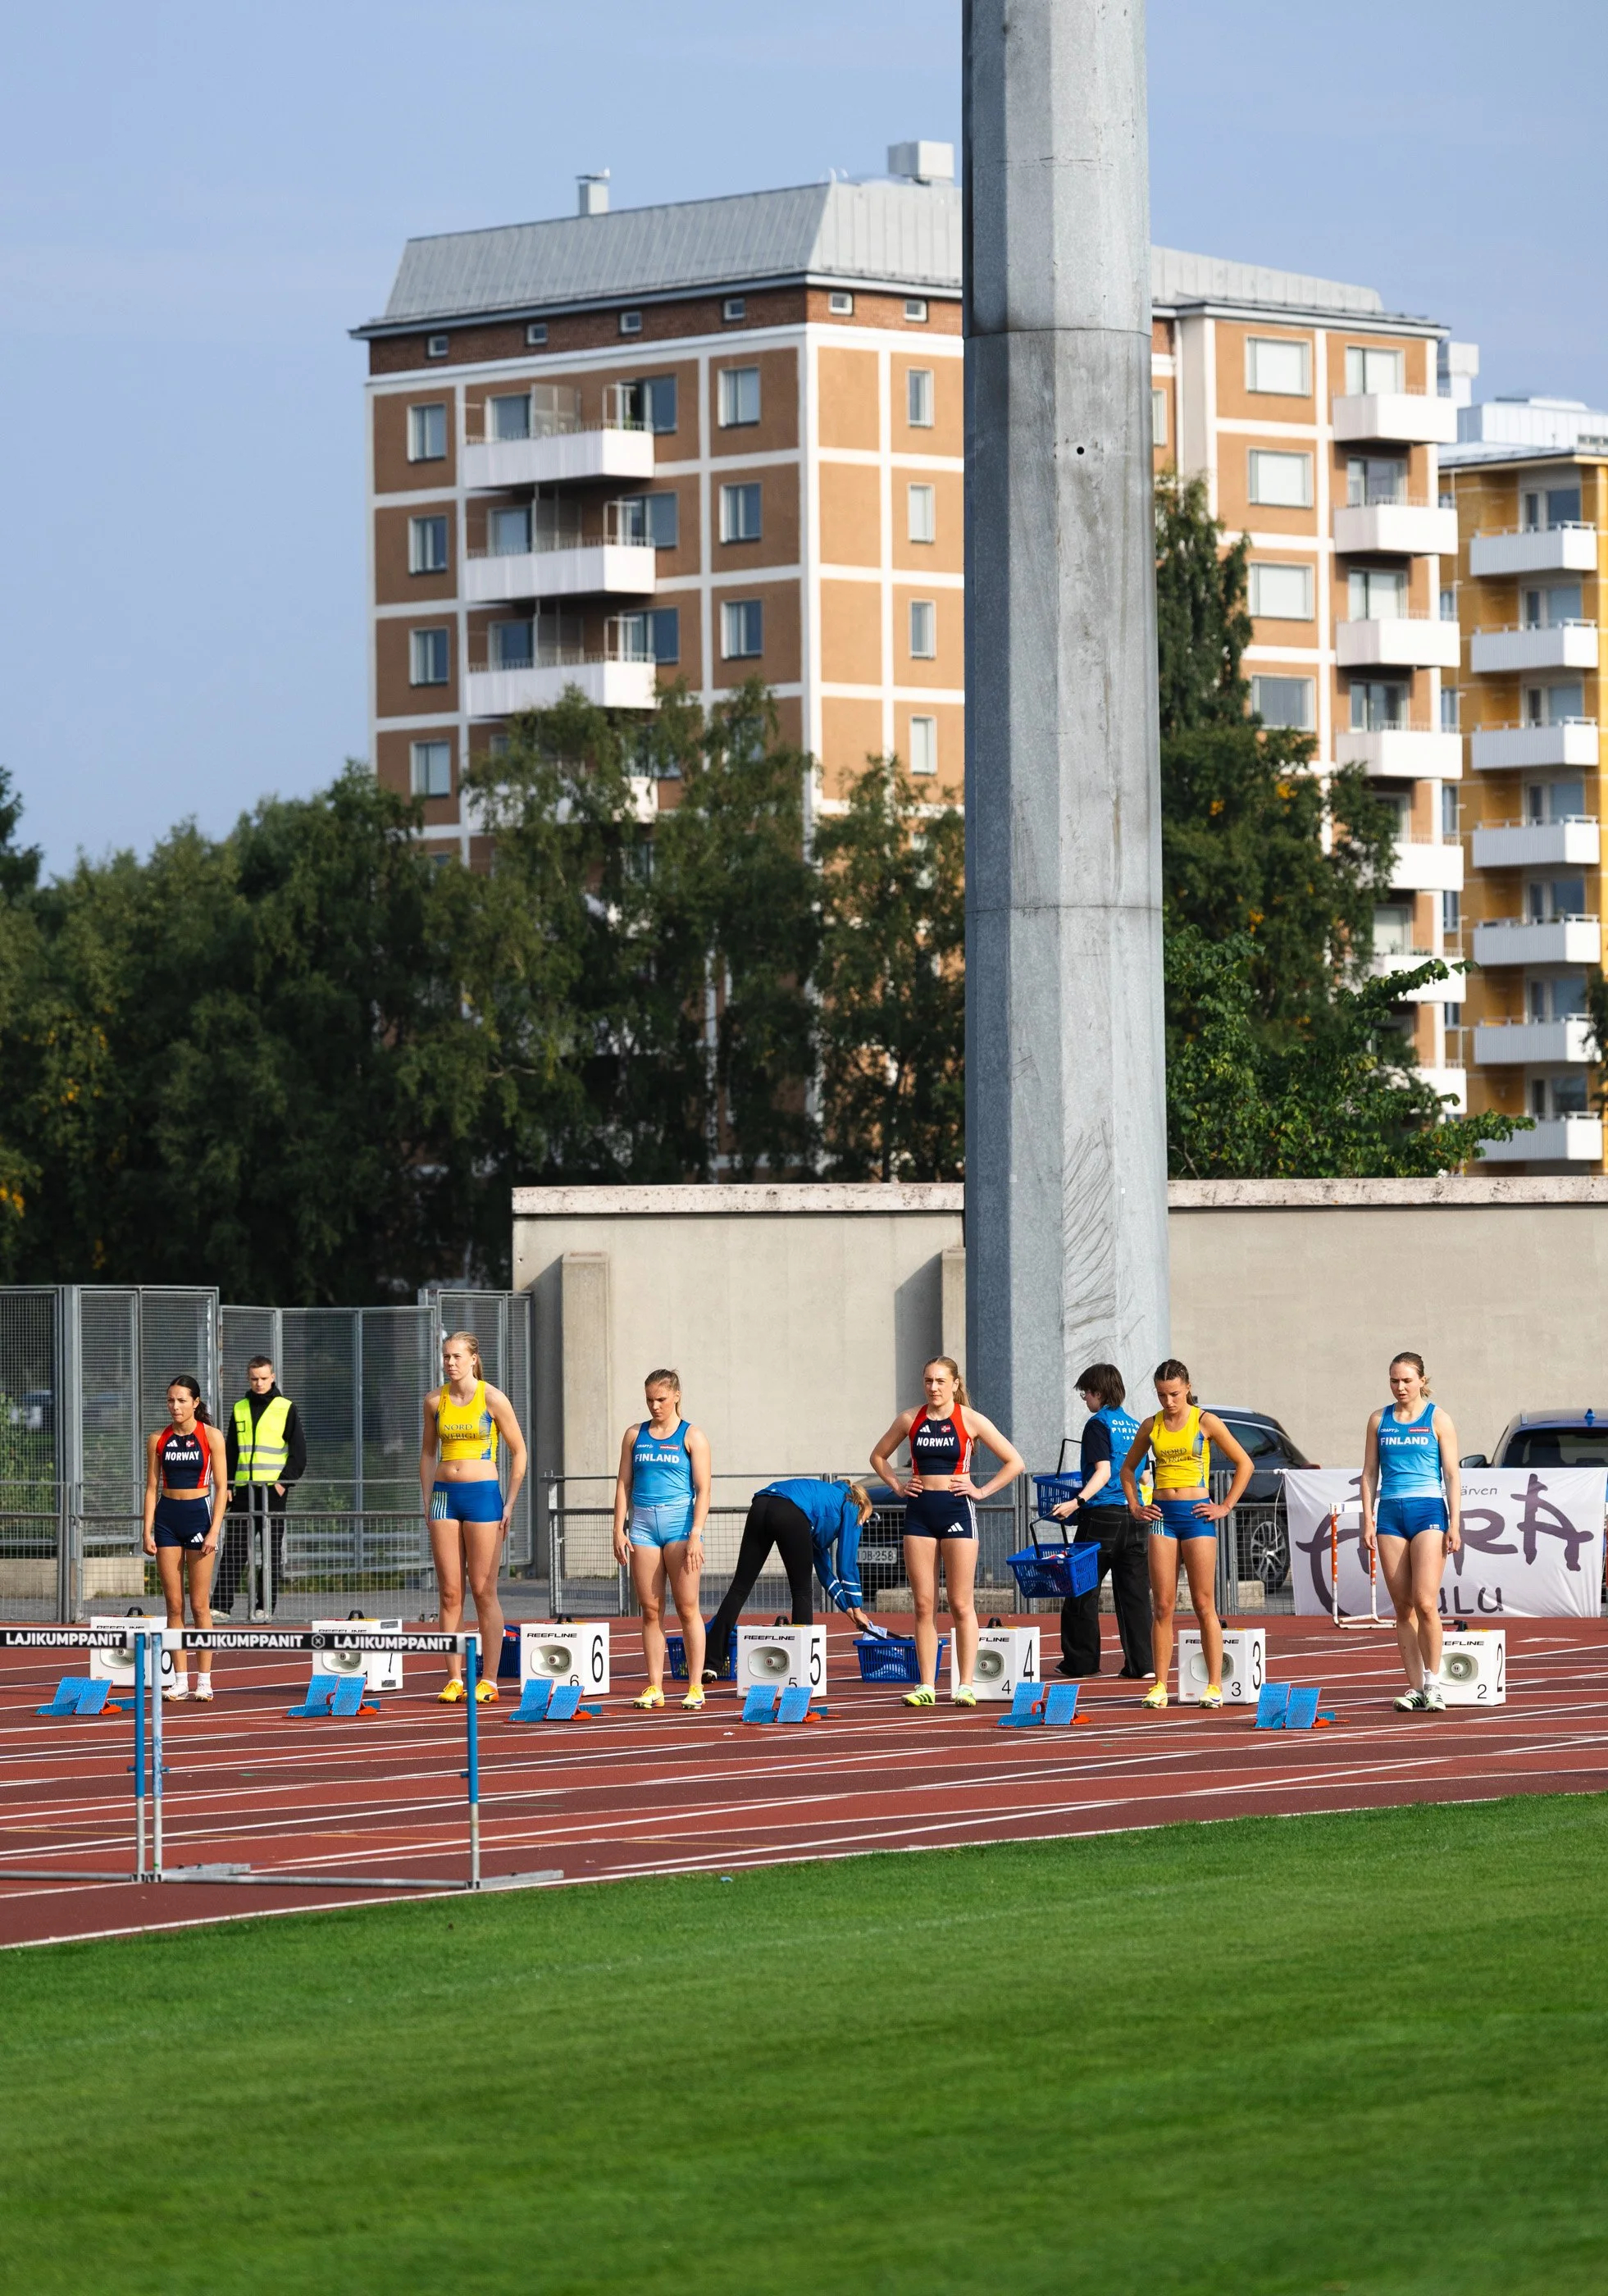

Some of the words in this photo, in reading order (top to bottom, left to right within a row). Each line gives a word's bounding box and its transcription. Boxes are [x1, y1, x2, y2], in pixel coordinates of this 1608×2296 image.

[917, 1437, 955, 1446] NORWAY
[1380, 1436, 1429, 1446] FINLAND
[165, 1451, 200, 1461] NORWAY
[635, 1453, 680, 1464] FINLAND
[1159, 1447, 1187, 1456] NORD
[6, 1632, 122, 1647] LAJIKUMPPANIT
[186, 1633, 303, 1648] LAJIKUMPPANIT
[334, 1635, 453, 1651] LAJIKUMPPANIT
[591, 1634, 604, 1683] 6
[809, 1638, 821, 1686] 5
[1023, 1639, 1034, 1683] 4
[1252, 1641, 1262, 1690] 3
[1496, 1642, 1503, 1692] 2
[1001, 1679, 1012, 1694] 4
[1231, 1682, 1241, 1697] 3
[1477, 1683, 1487, 1699] 2
